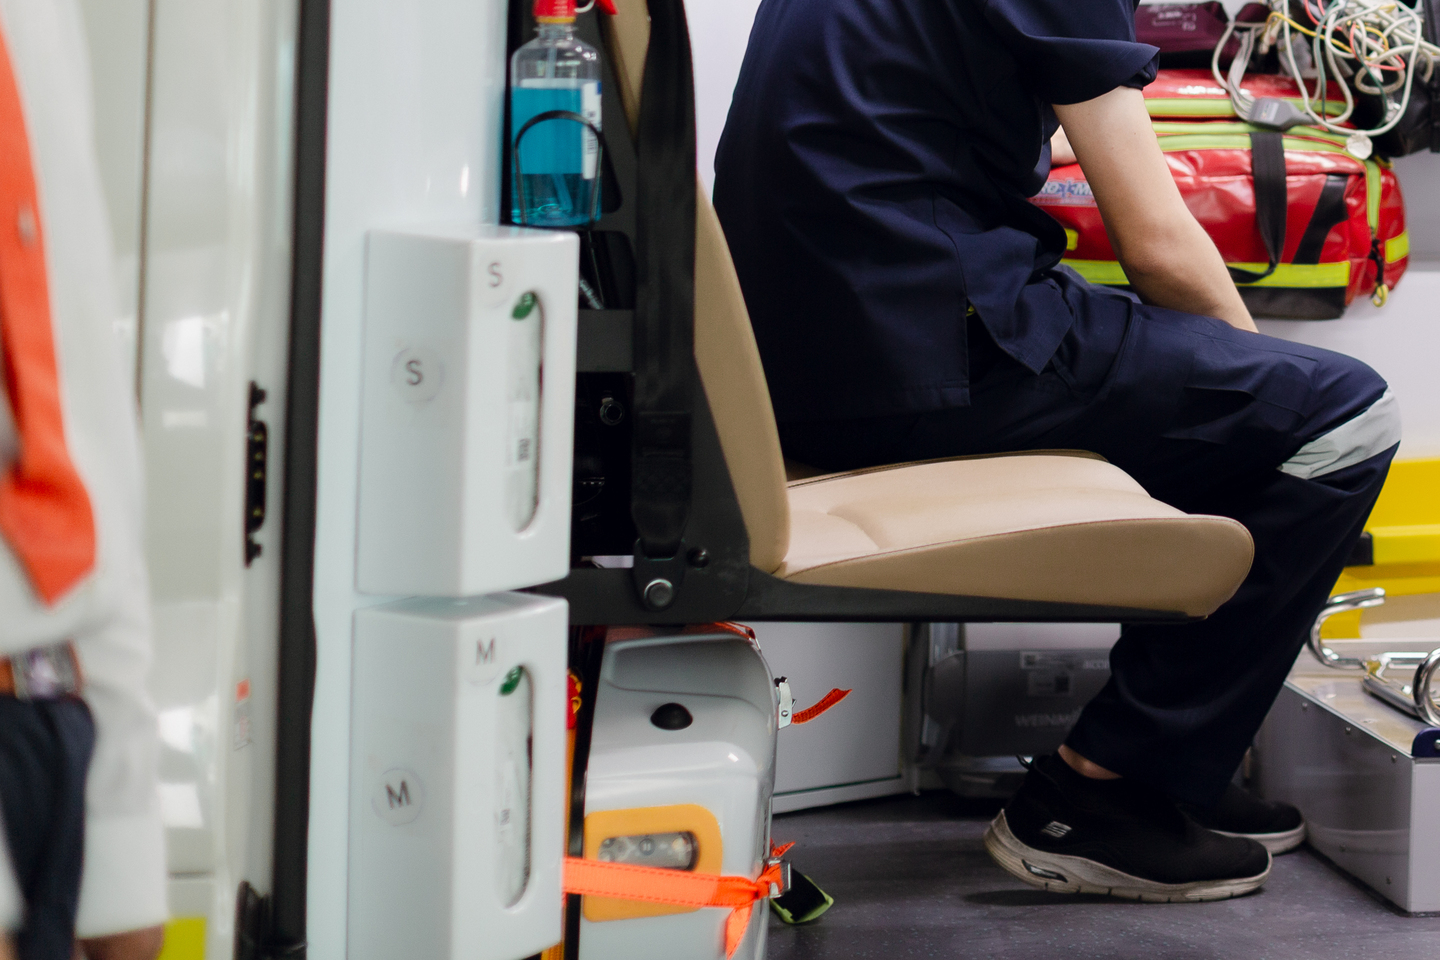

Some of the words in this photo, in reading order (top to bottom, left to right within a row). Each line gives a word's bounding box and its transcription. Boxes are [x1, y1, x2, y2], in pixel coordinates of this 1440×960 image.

[487, 261, 504, 288] S
[405, 359, 424, 386] S
[475, 638, 496, 666] M
[385, 780, 412, 809] M
